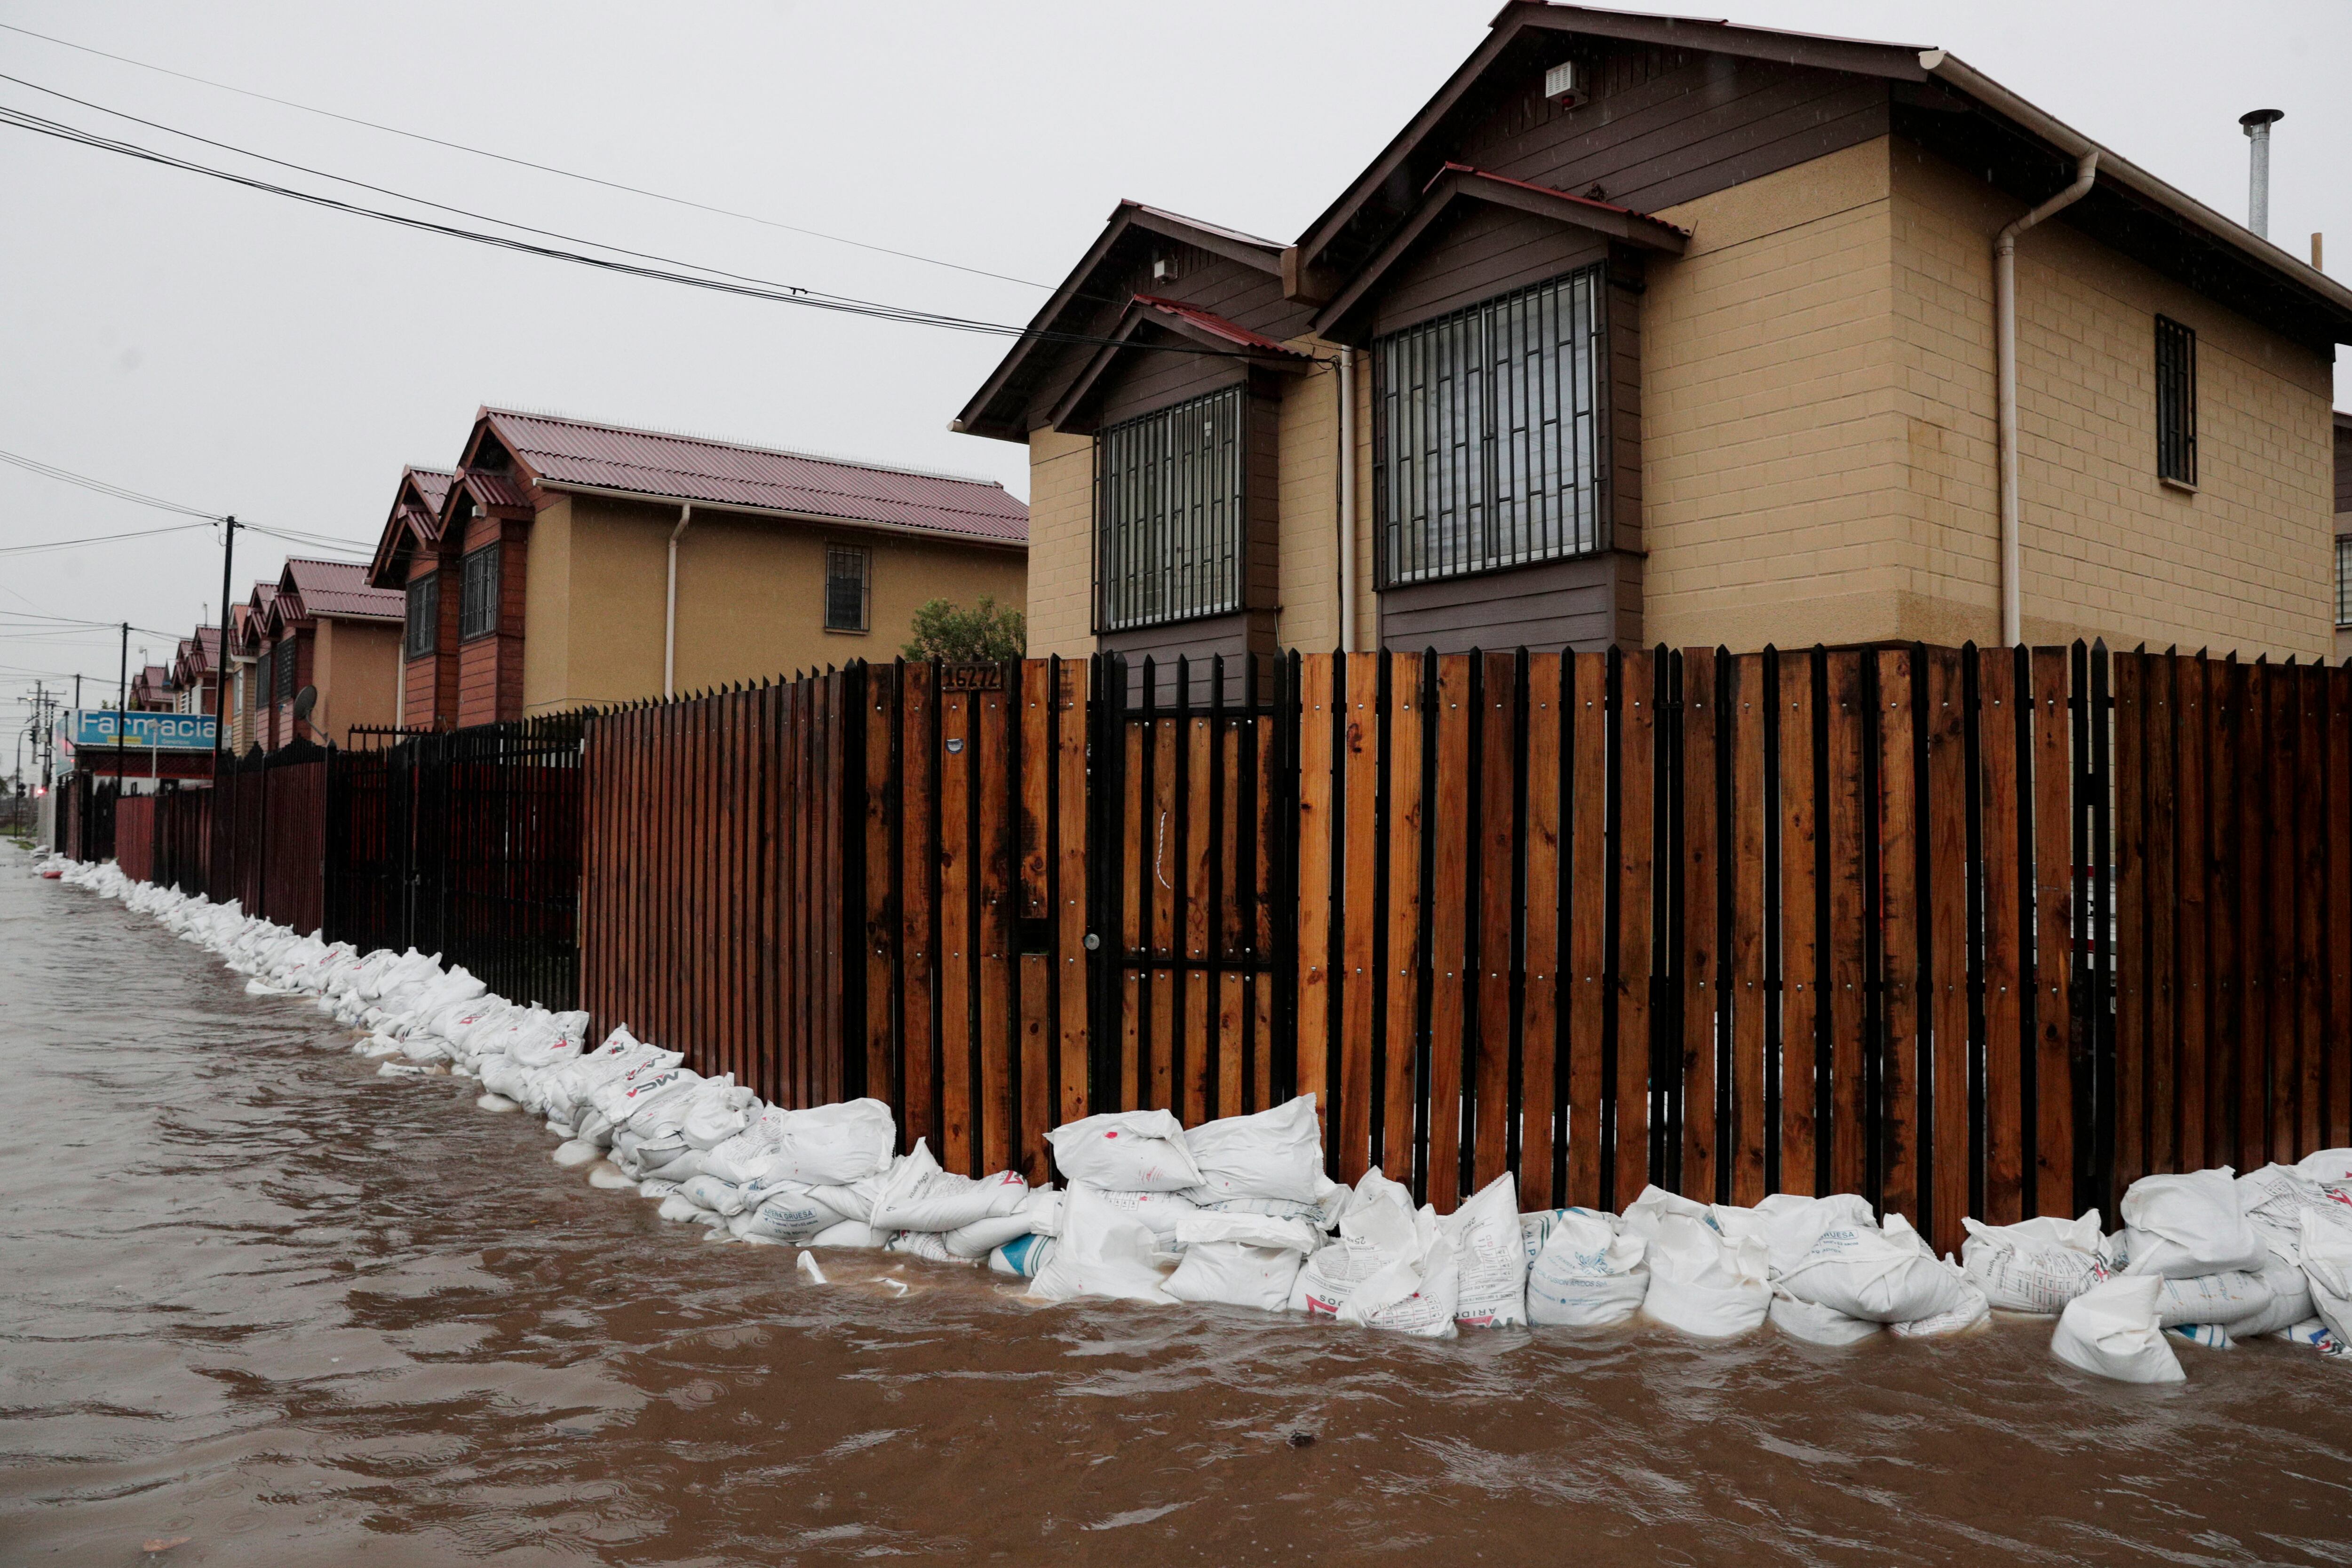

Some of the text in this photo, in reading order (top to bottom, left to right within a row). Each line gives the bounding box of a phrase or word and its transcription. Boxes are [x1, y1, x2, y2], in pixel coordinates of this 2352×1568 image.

[945, 666, 997, 687] 16272
[764, 1209, 813, 1220] ARENA GRUESA
[1547, 1275, 1569, 1286] FUSION
